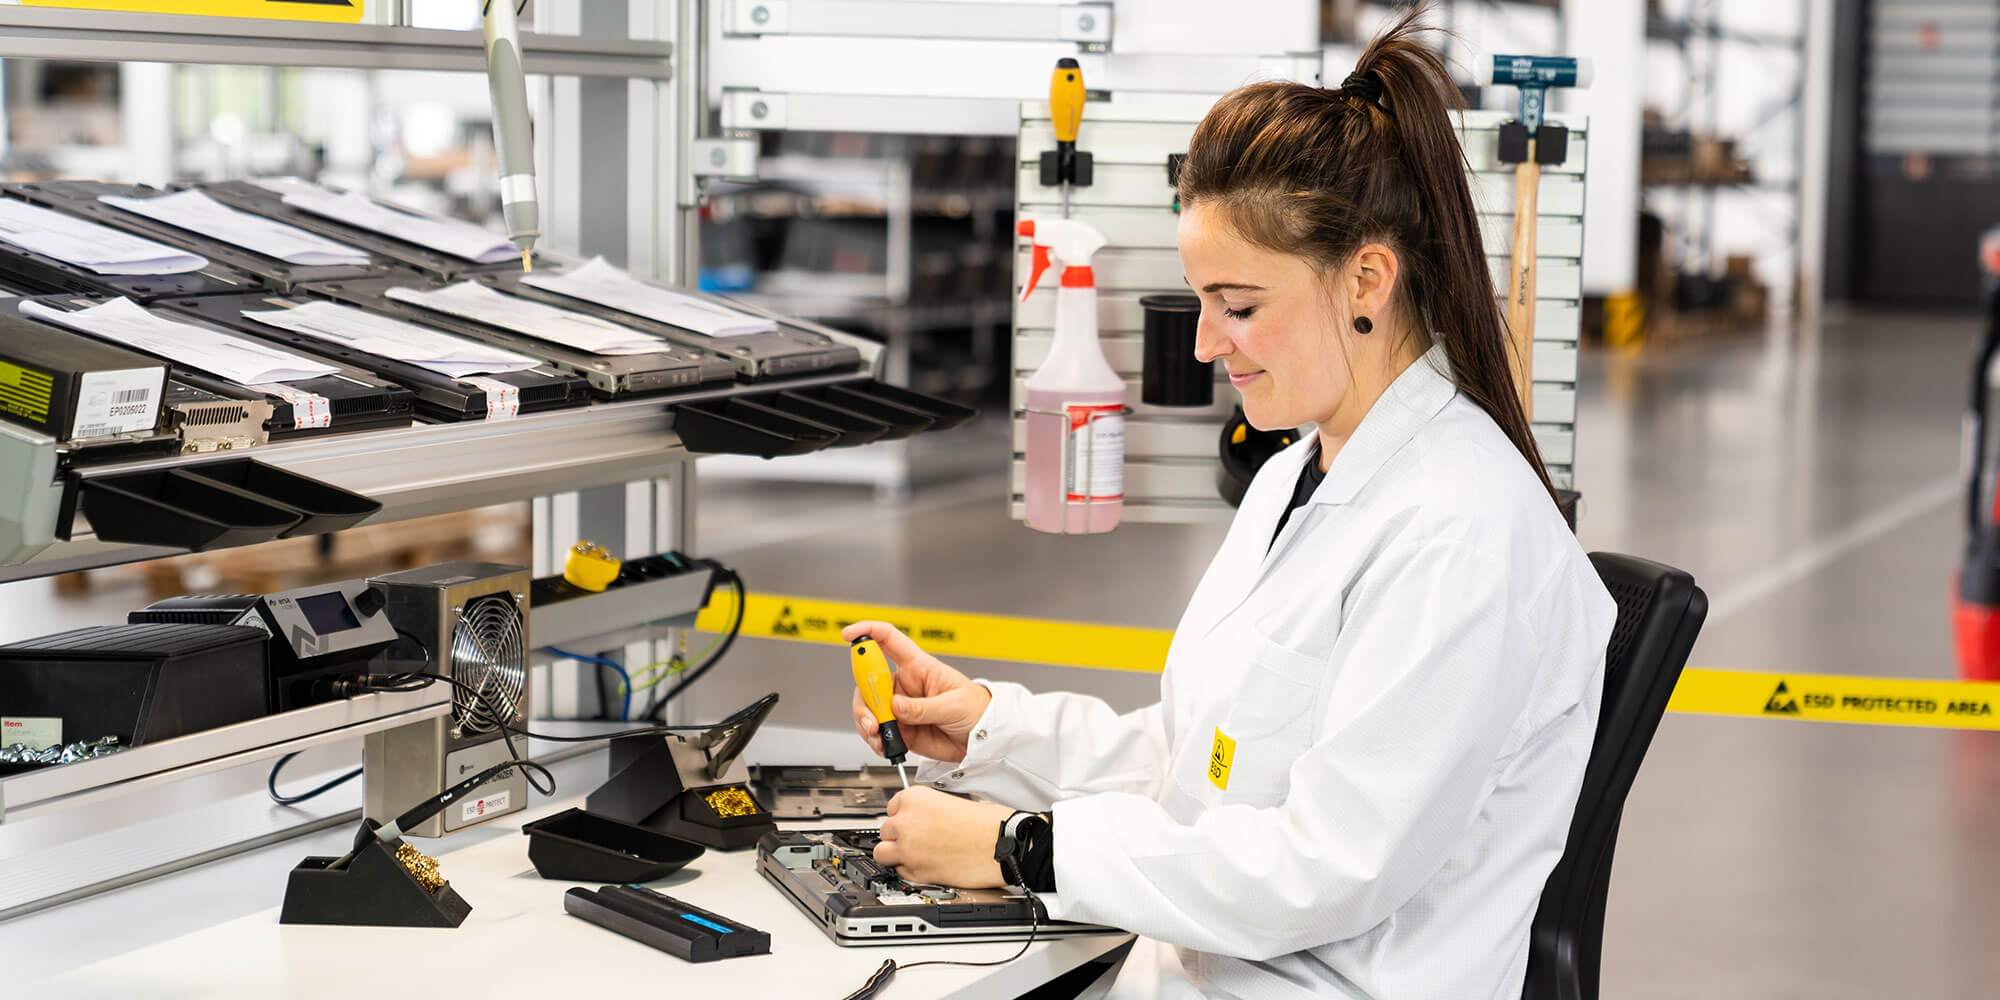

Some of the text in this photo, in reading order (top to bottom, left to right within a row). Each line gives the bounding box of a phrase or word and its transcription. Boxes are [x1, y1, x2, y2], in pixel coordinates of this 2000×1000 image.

[1804, 694, 1993, 717] ESD PROTECTED AREA
[1210, 761, 1222, 778] ESD
